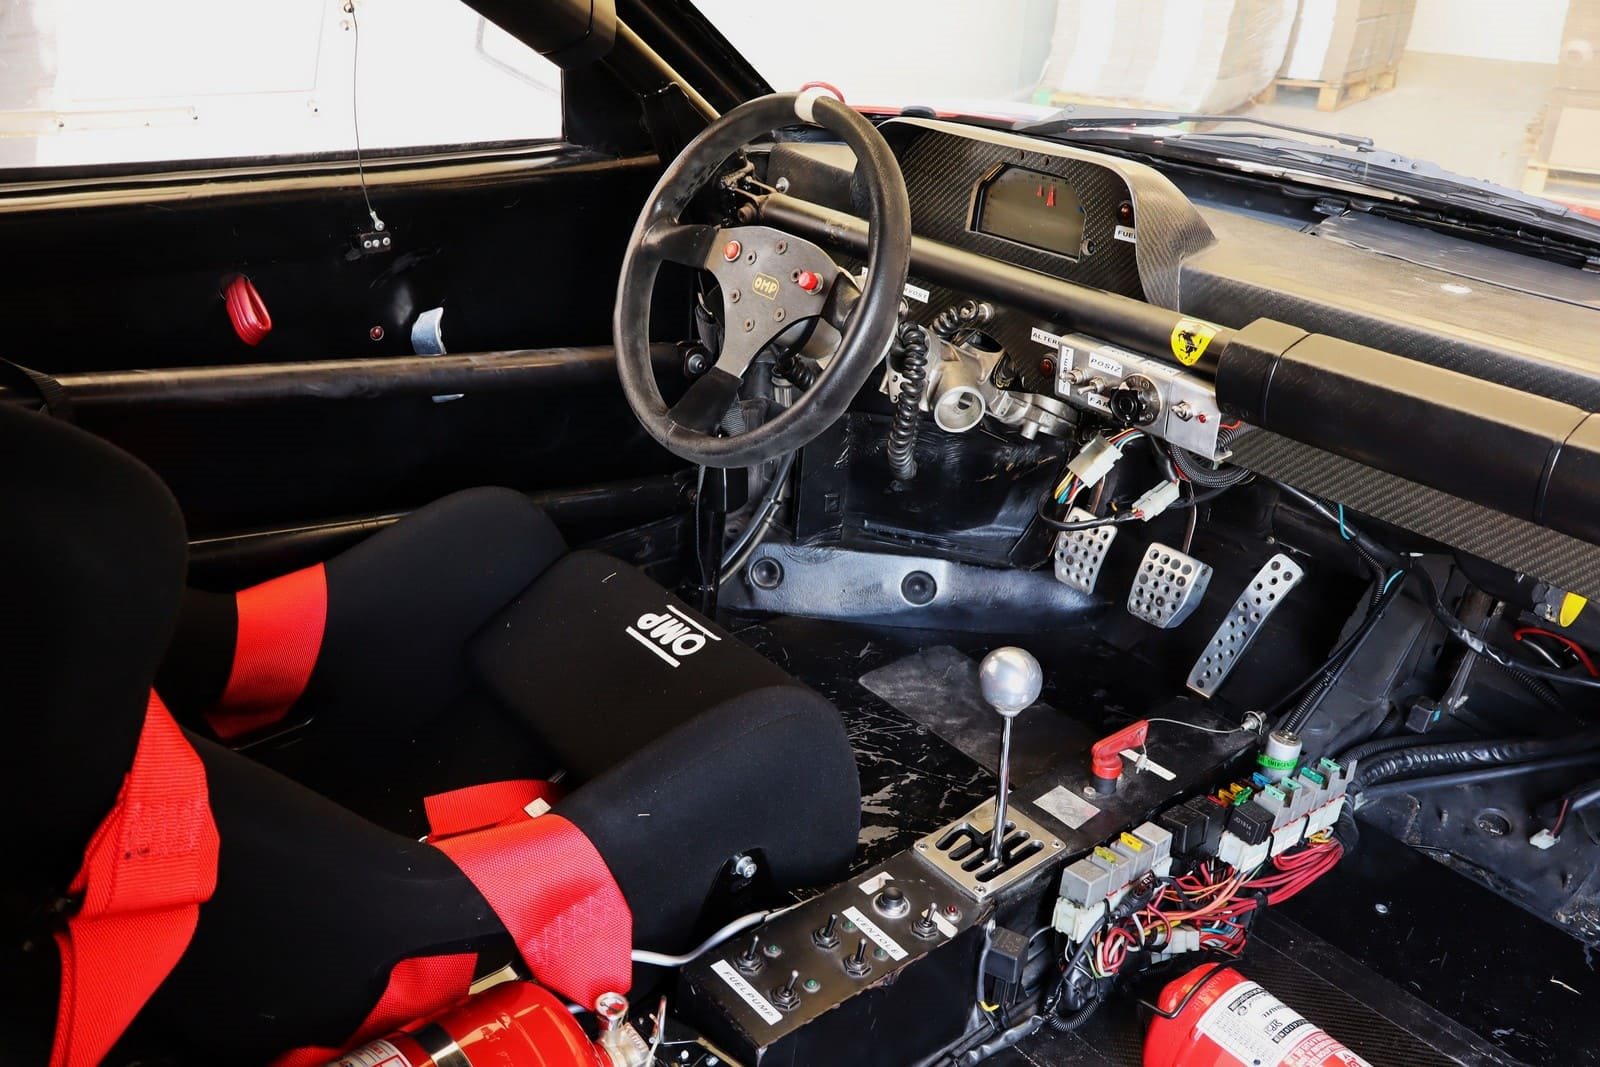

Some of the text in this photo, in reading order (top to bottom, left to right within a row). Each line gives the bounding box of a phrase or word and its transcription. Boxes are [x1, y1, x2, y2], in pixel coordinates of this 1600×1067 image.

[754, 277, 778, 294] OMP
[1090, 358, 1121, 372] POSIZ
[637, 612, 706, 656] OMP
[856, 917, 900, 954] VENTOLE
